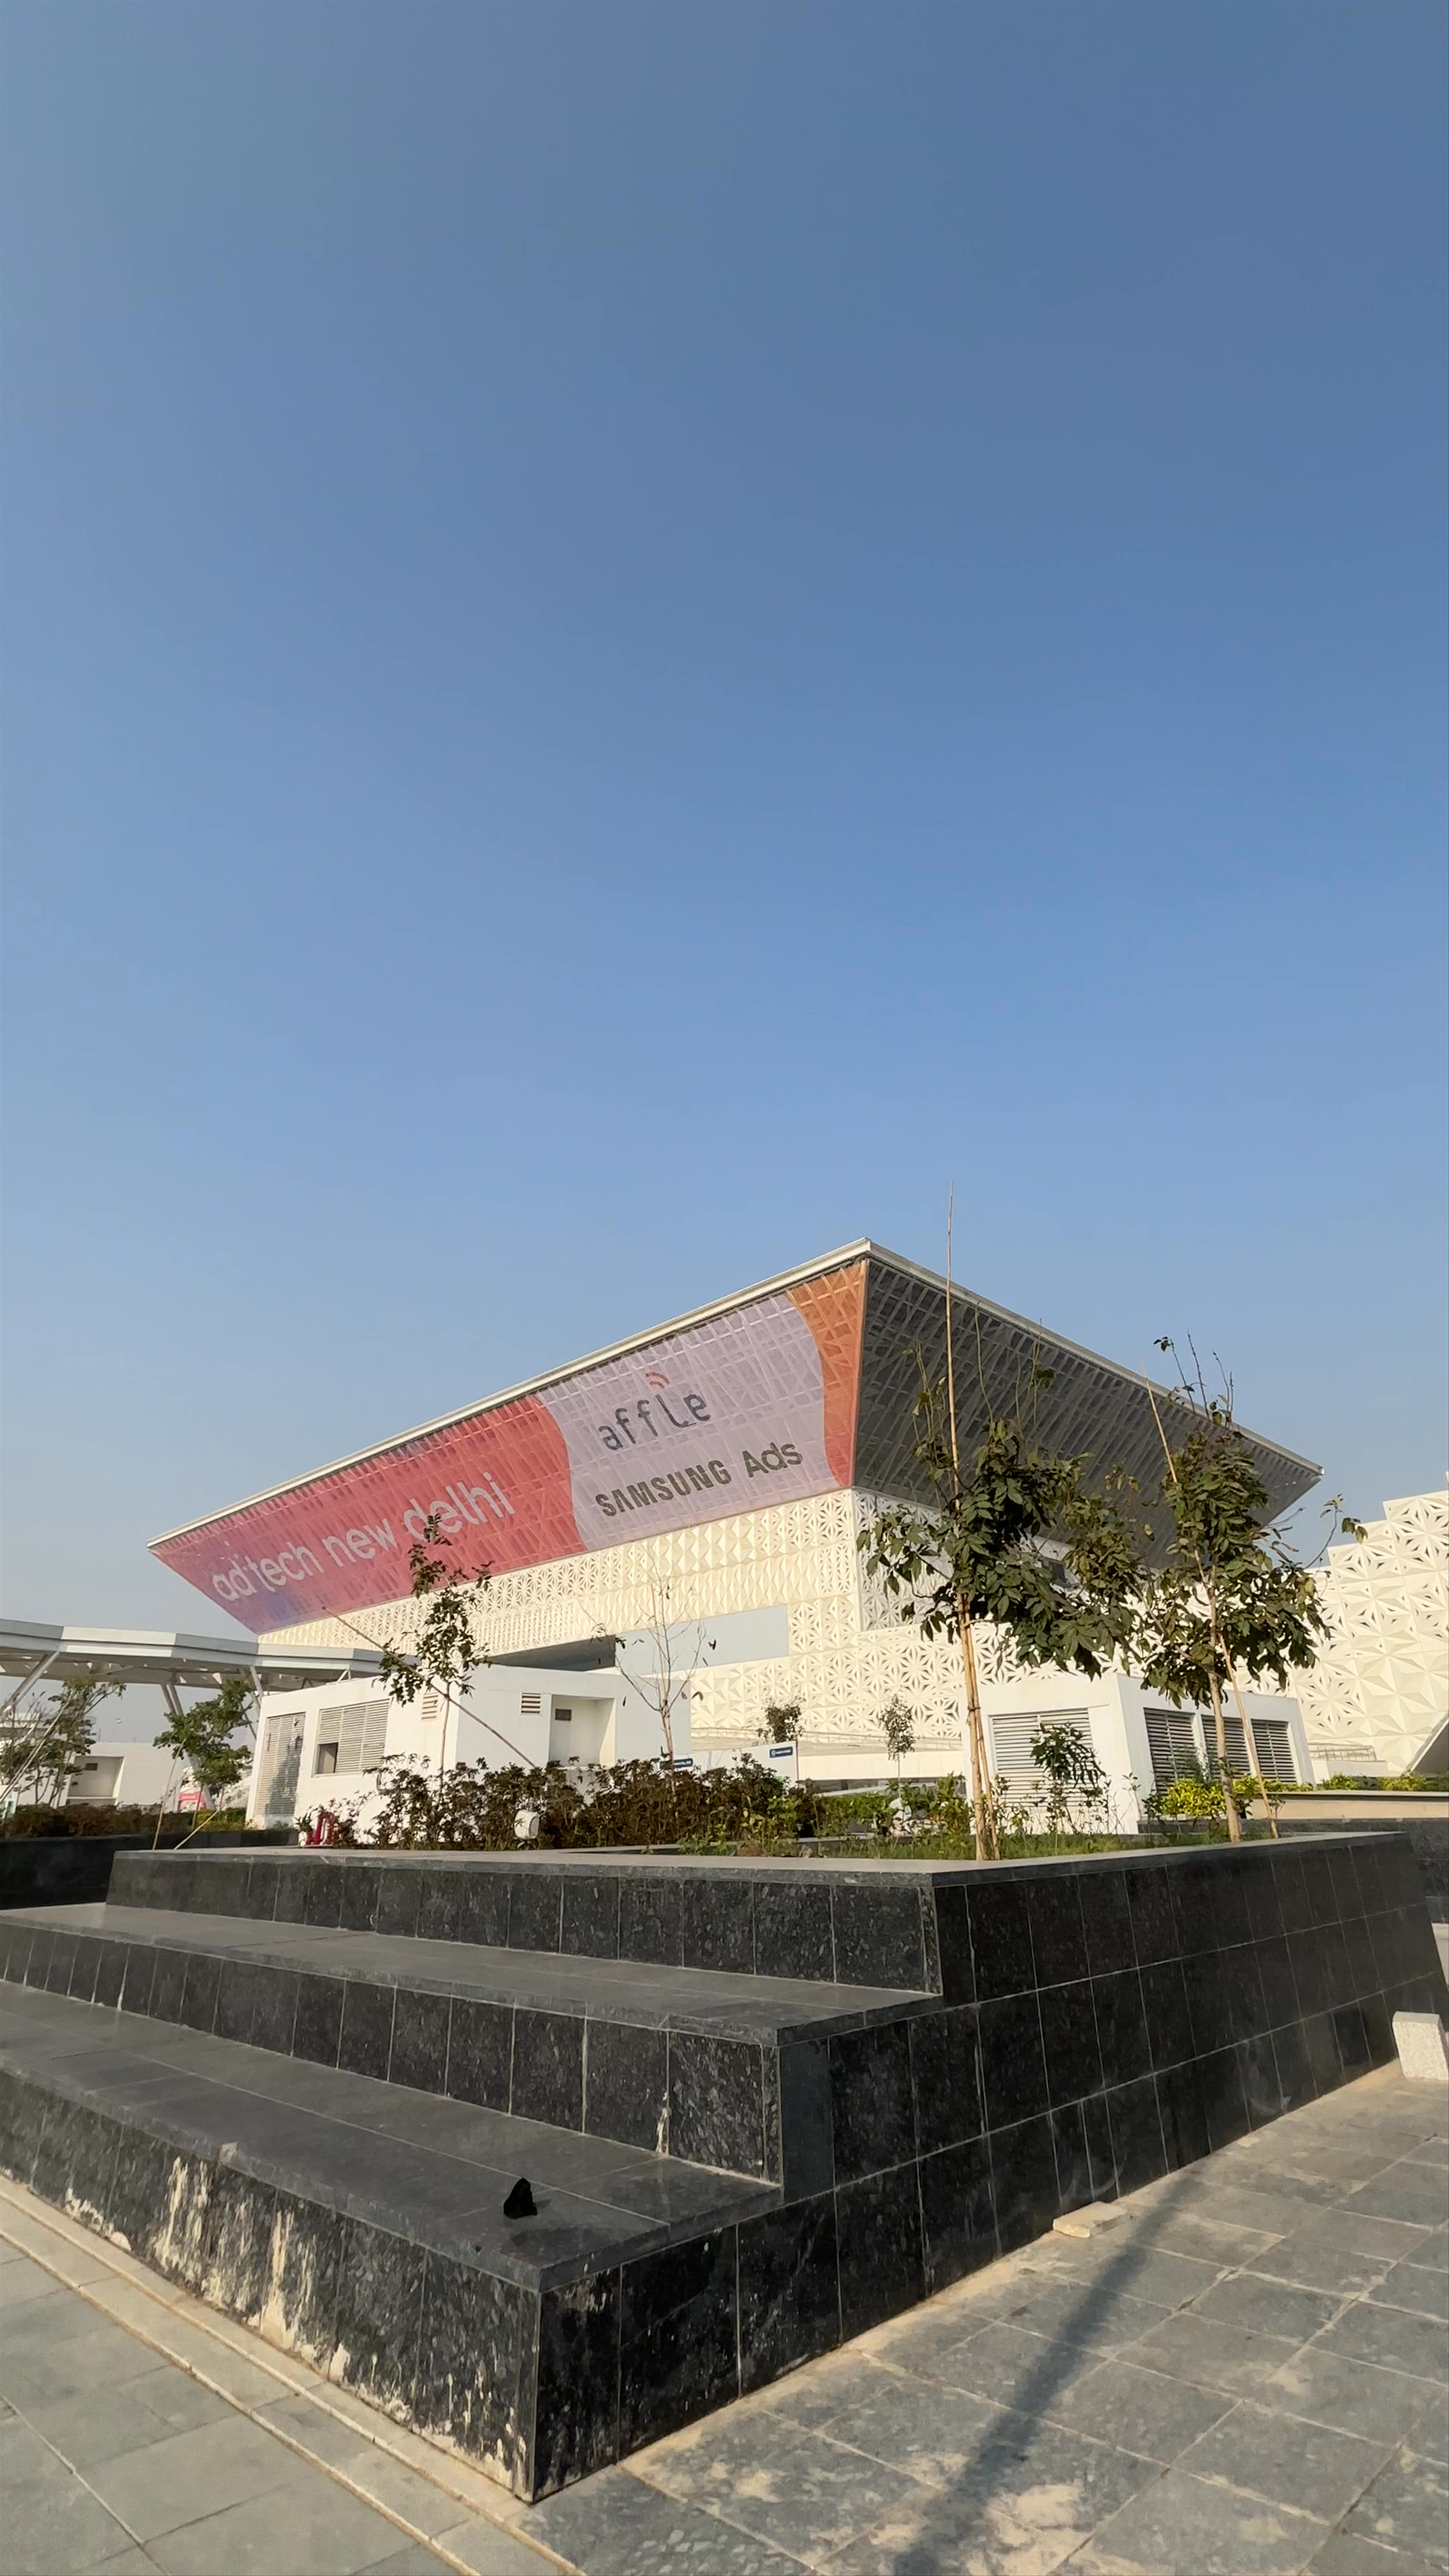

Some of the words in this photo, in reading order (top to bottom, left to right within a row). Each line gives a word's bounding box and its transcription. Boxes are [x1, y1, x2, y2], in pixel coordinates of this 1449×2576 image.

[322, 1519, 397, 1567] new
[404, 1472, 515, 1543] delhi
[595, 1460, 732, 1516] SAMSUNG
[742, 1442, 803, 1478] Ads
